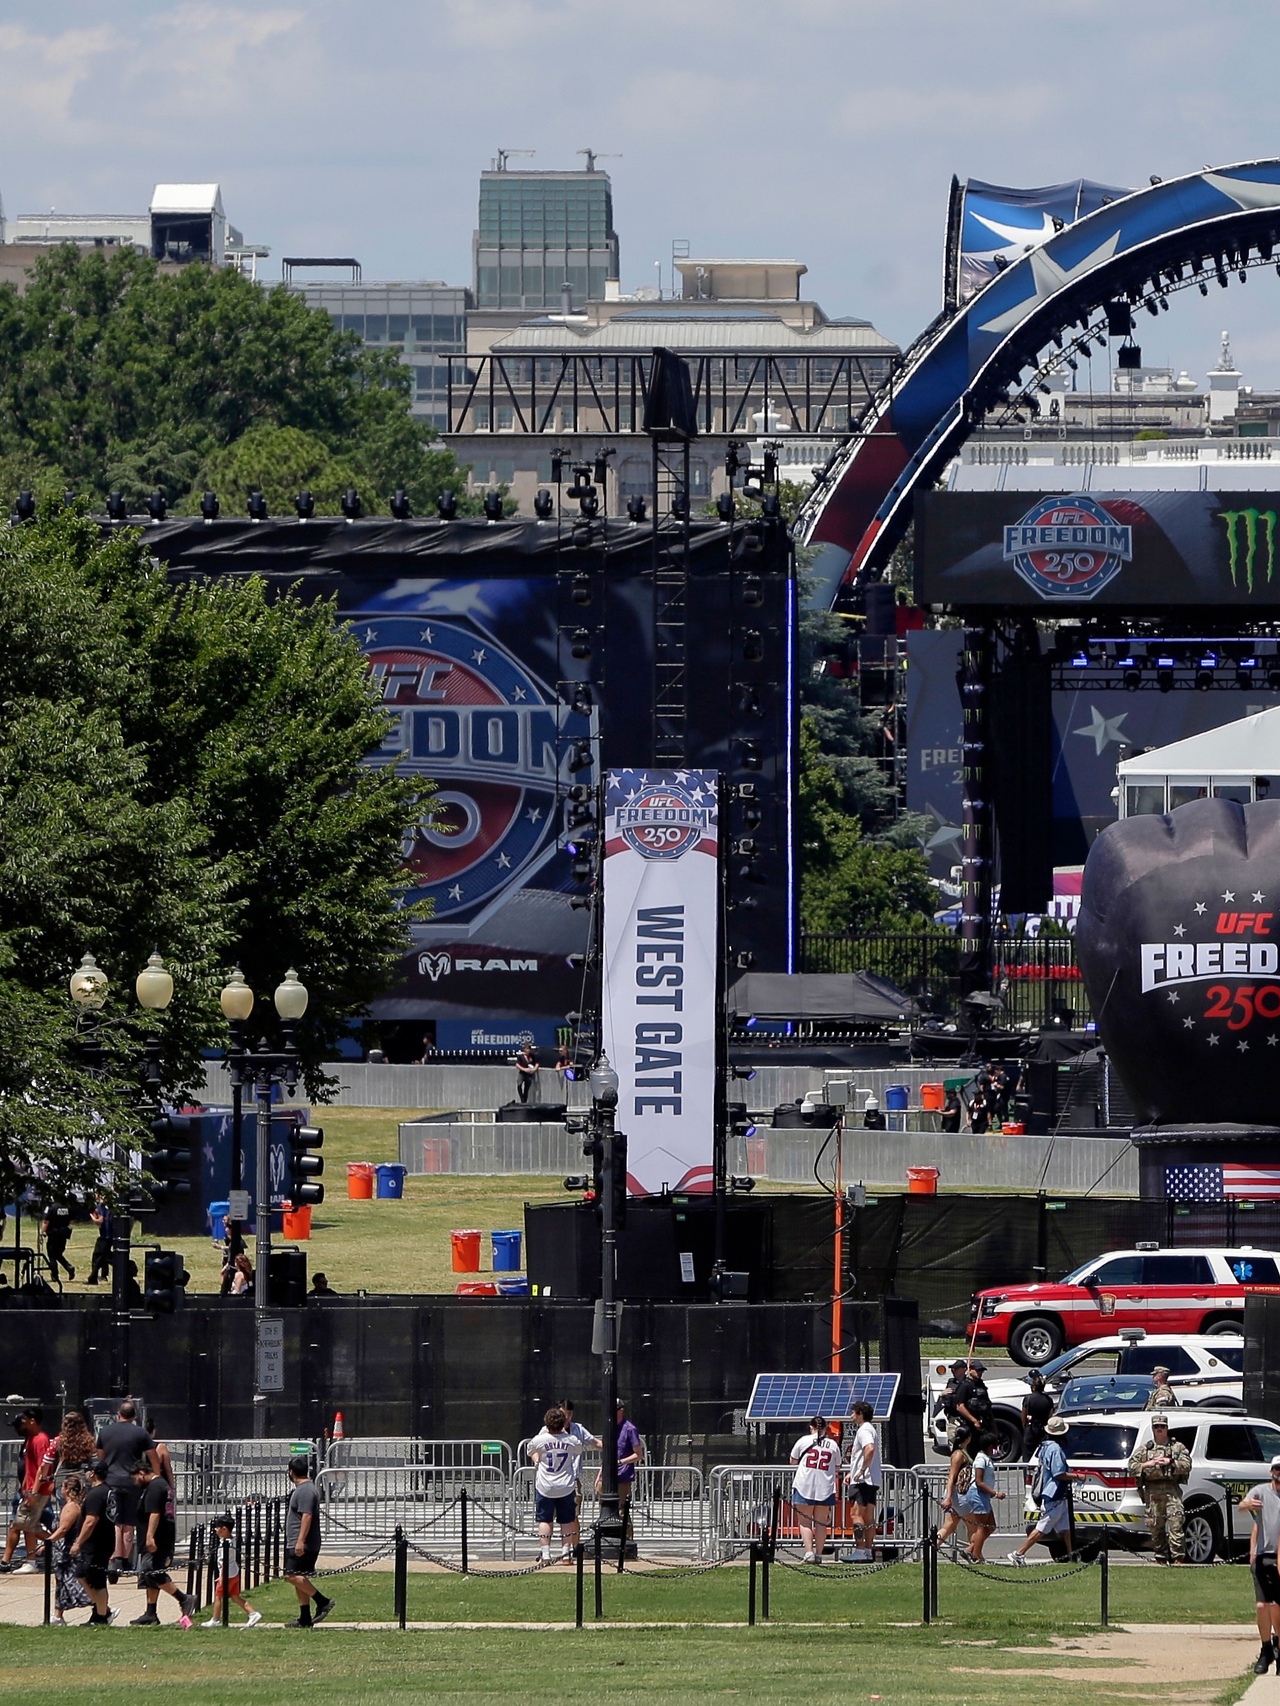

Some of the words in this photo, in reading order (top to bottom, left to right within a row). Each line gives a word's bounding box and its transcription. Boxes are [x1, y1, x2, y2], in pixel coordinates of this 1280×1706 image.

[1051, 512, 1085, 524] UFC
[1005, 526, 1130, 553] FREEDOM
[1043, 552, 1095, 579] 250
[649, 798, 675, 807] UFC
[616, 808, 708, 828] FREEDOM
[643, 828, 681, 847] 250
[1216, 913, 1274, 934] UFC
[455, 959, 538, 971] RAM
[636, 905, 684, 1011] WEST
[635, 1023, 683, 1115] GATE
[544, 1441, 569, 1451] BRYANT
[546, 1452, 569, 1472] 17
[806, 1449, 832, 1471] 22
[1081, 1491, 1121, 1502] POLICE
